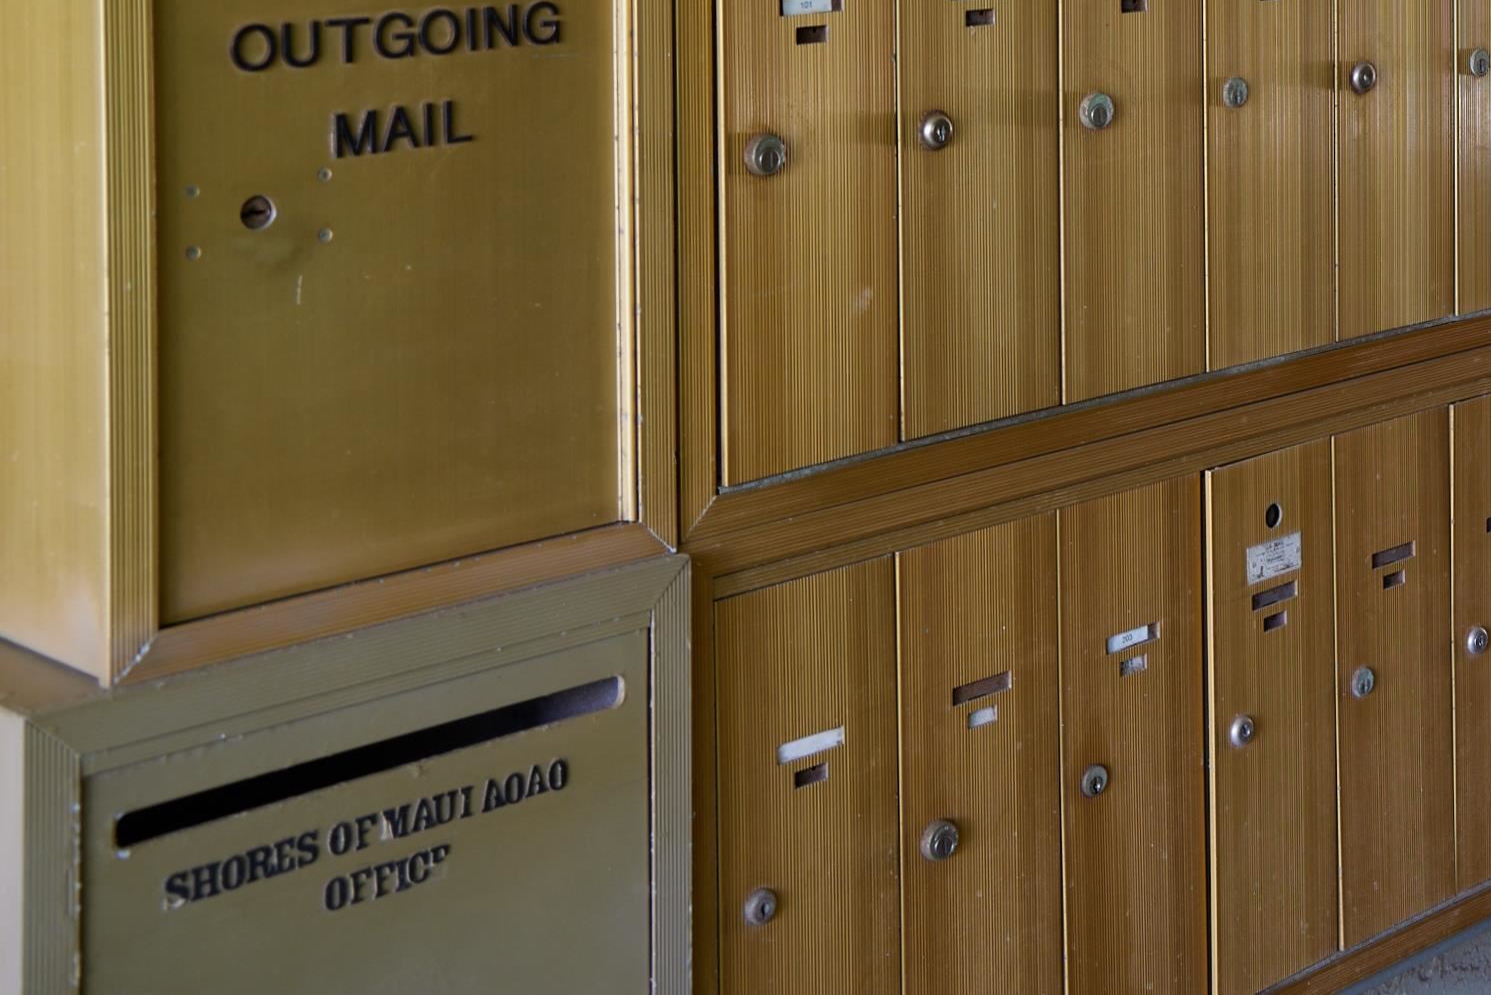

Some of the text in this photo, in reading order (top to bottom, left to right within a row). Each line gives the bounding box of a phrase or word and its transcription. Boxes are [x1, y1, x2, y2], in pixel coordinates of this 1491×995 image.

[229, 1, 563, 73] OUTGOING
[331, 100, 475, 159] MAIL
[163, 758, 569, 910] SHORES OF MAUI AOAO
